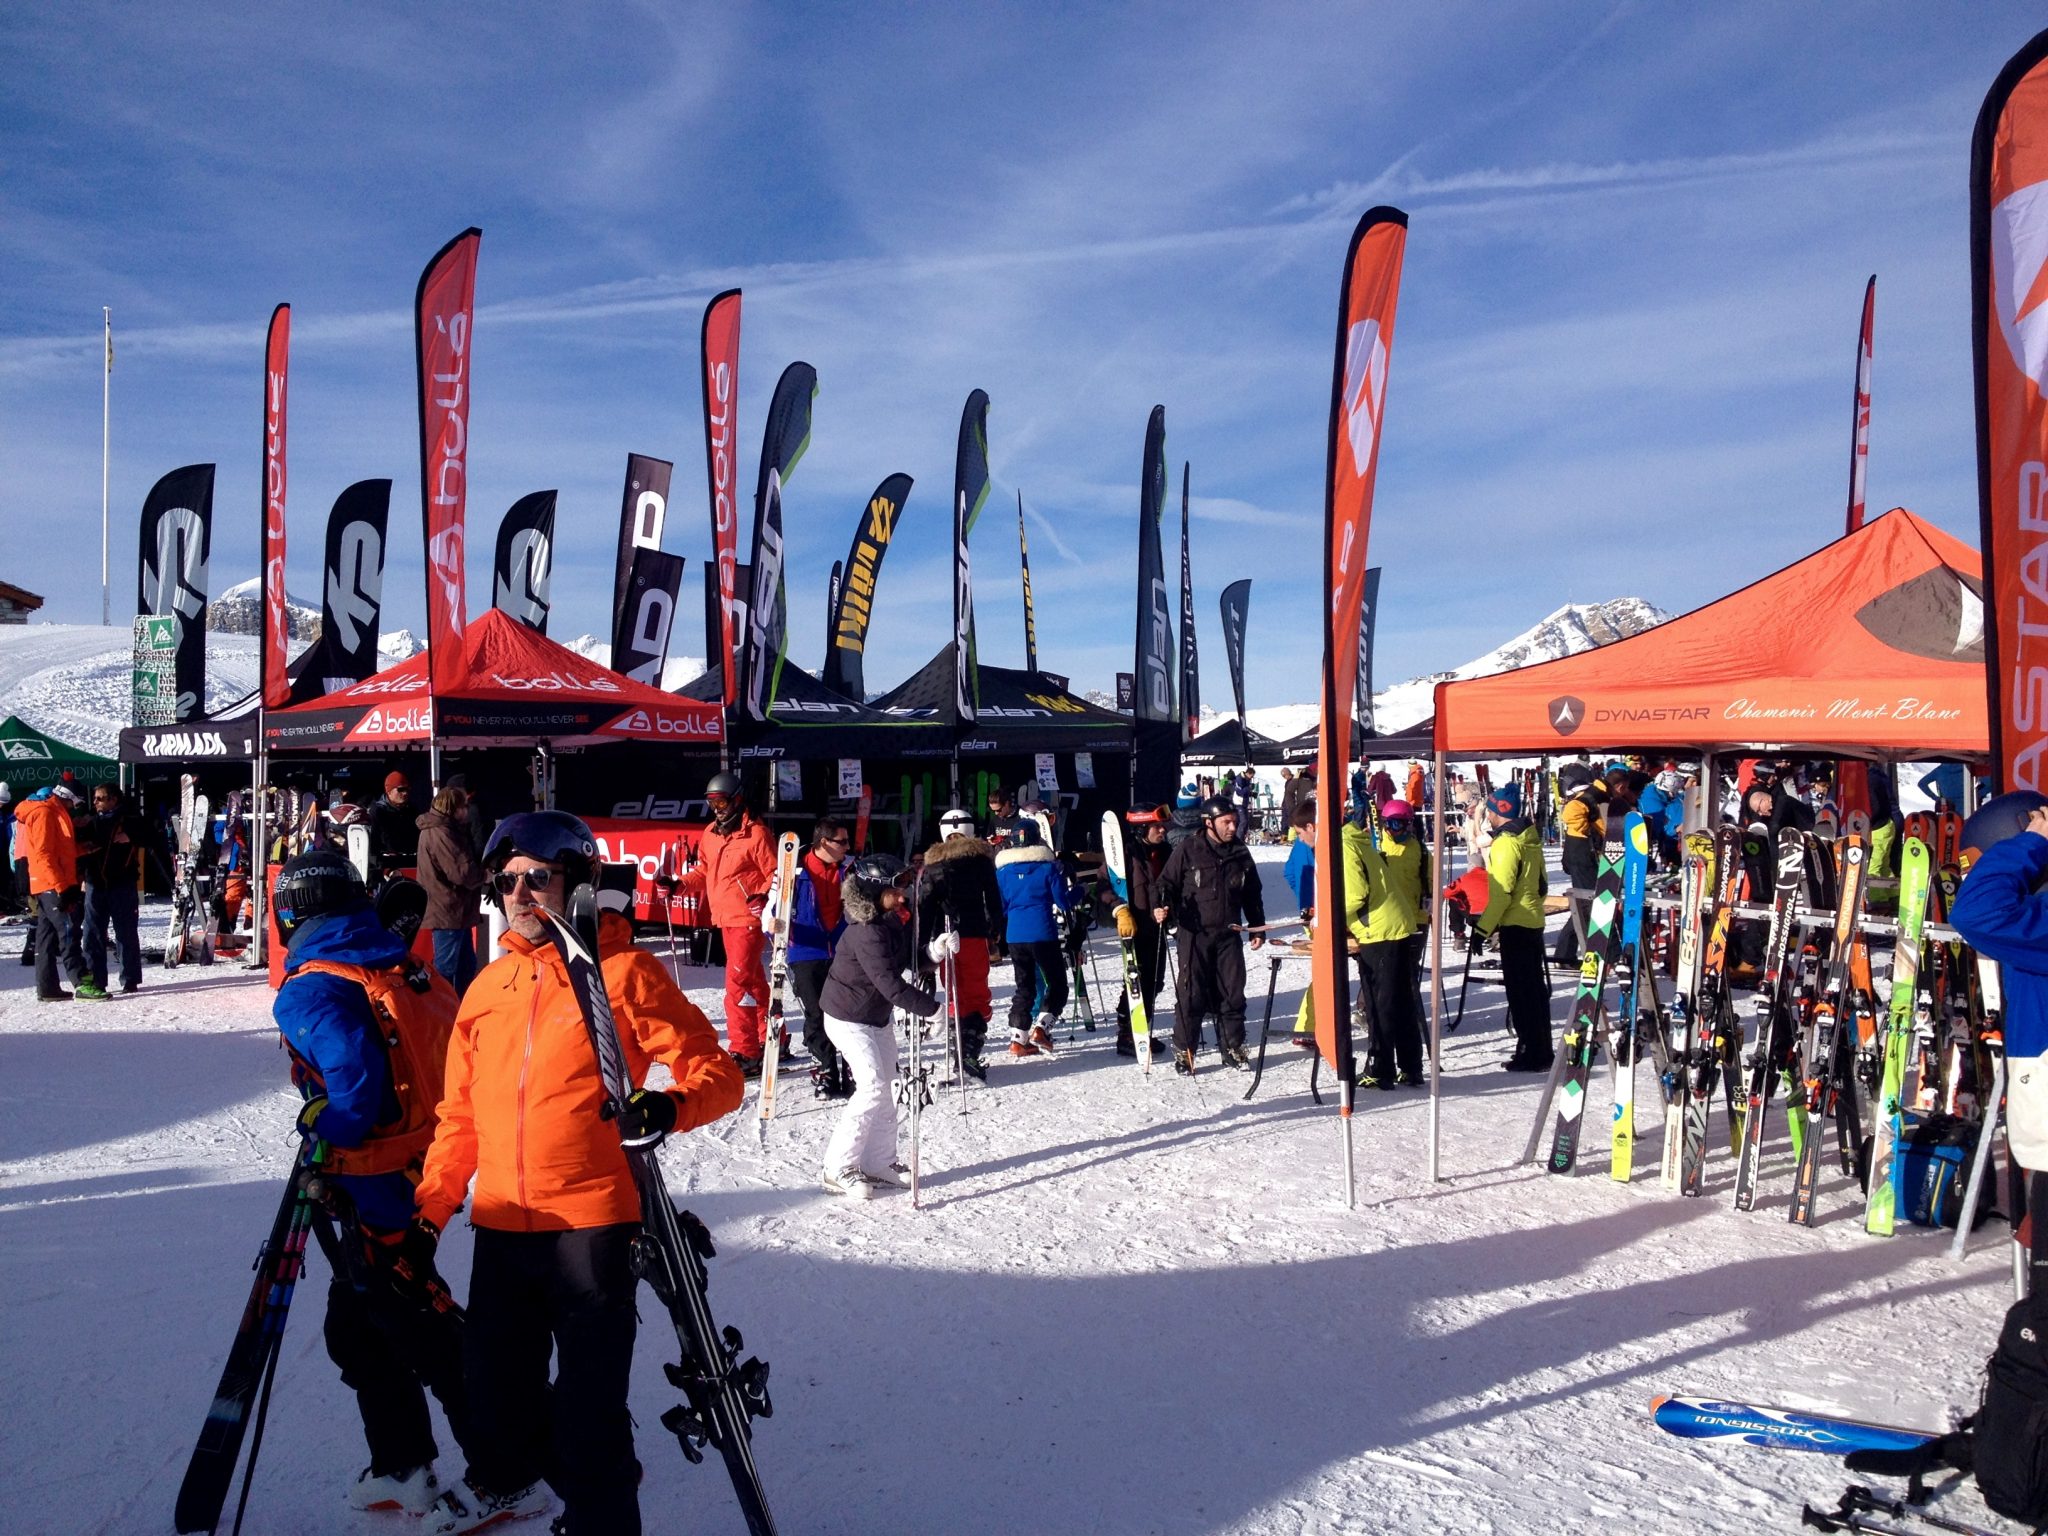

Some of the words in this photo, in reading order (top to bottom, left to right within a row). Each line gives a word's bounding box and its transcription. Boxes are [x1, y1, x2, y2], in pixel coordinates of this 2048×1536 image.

[434, 311, 468, 505] bollé
[1147, 576, 1170, 715] elan
[492, 671, 621, 693] bollé
[770, 697, 860, 713] elan
[976, 705, 1053, 717] elan
[1595, 707, 1711, 722] DYNASTAR
[1723, 698, 1818, 720] Chamonix
[386, 708, 431, 734] bollé
[452, 715, 471, 724] YOU
[473, 715, 501, 725] NEVER
[547, 715, 574, 724] NEVER
[656, 711, 720, 735] bollé
[740, 745, 786, 757] elan
[960, 738, 998, 750] elan
[610, 794, 709, 820] elan
[1110, 834, 1119, 866] DYNASTAR
[292, 866, 345, 881] ATOMIC
[1719, 843, 1733, 903] DYNASTAR
[1840, 869, 1858, 930] DYNASTAR
[1904, 866, 1920, 939] DYNASTAR
[1777, 893, 1797, 960] ROSSIGNOL
[586, 971, 621, 1101] ATOMIC
[1694, 1414, 1813, 1438] ROSSIGNOL
